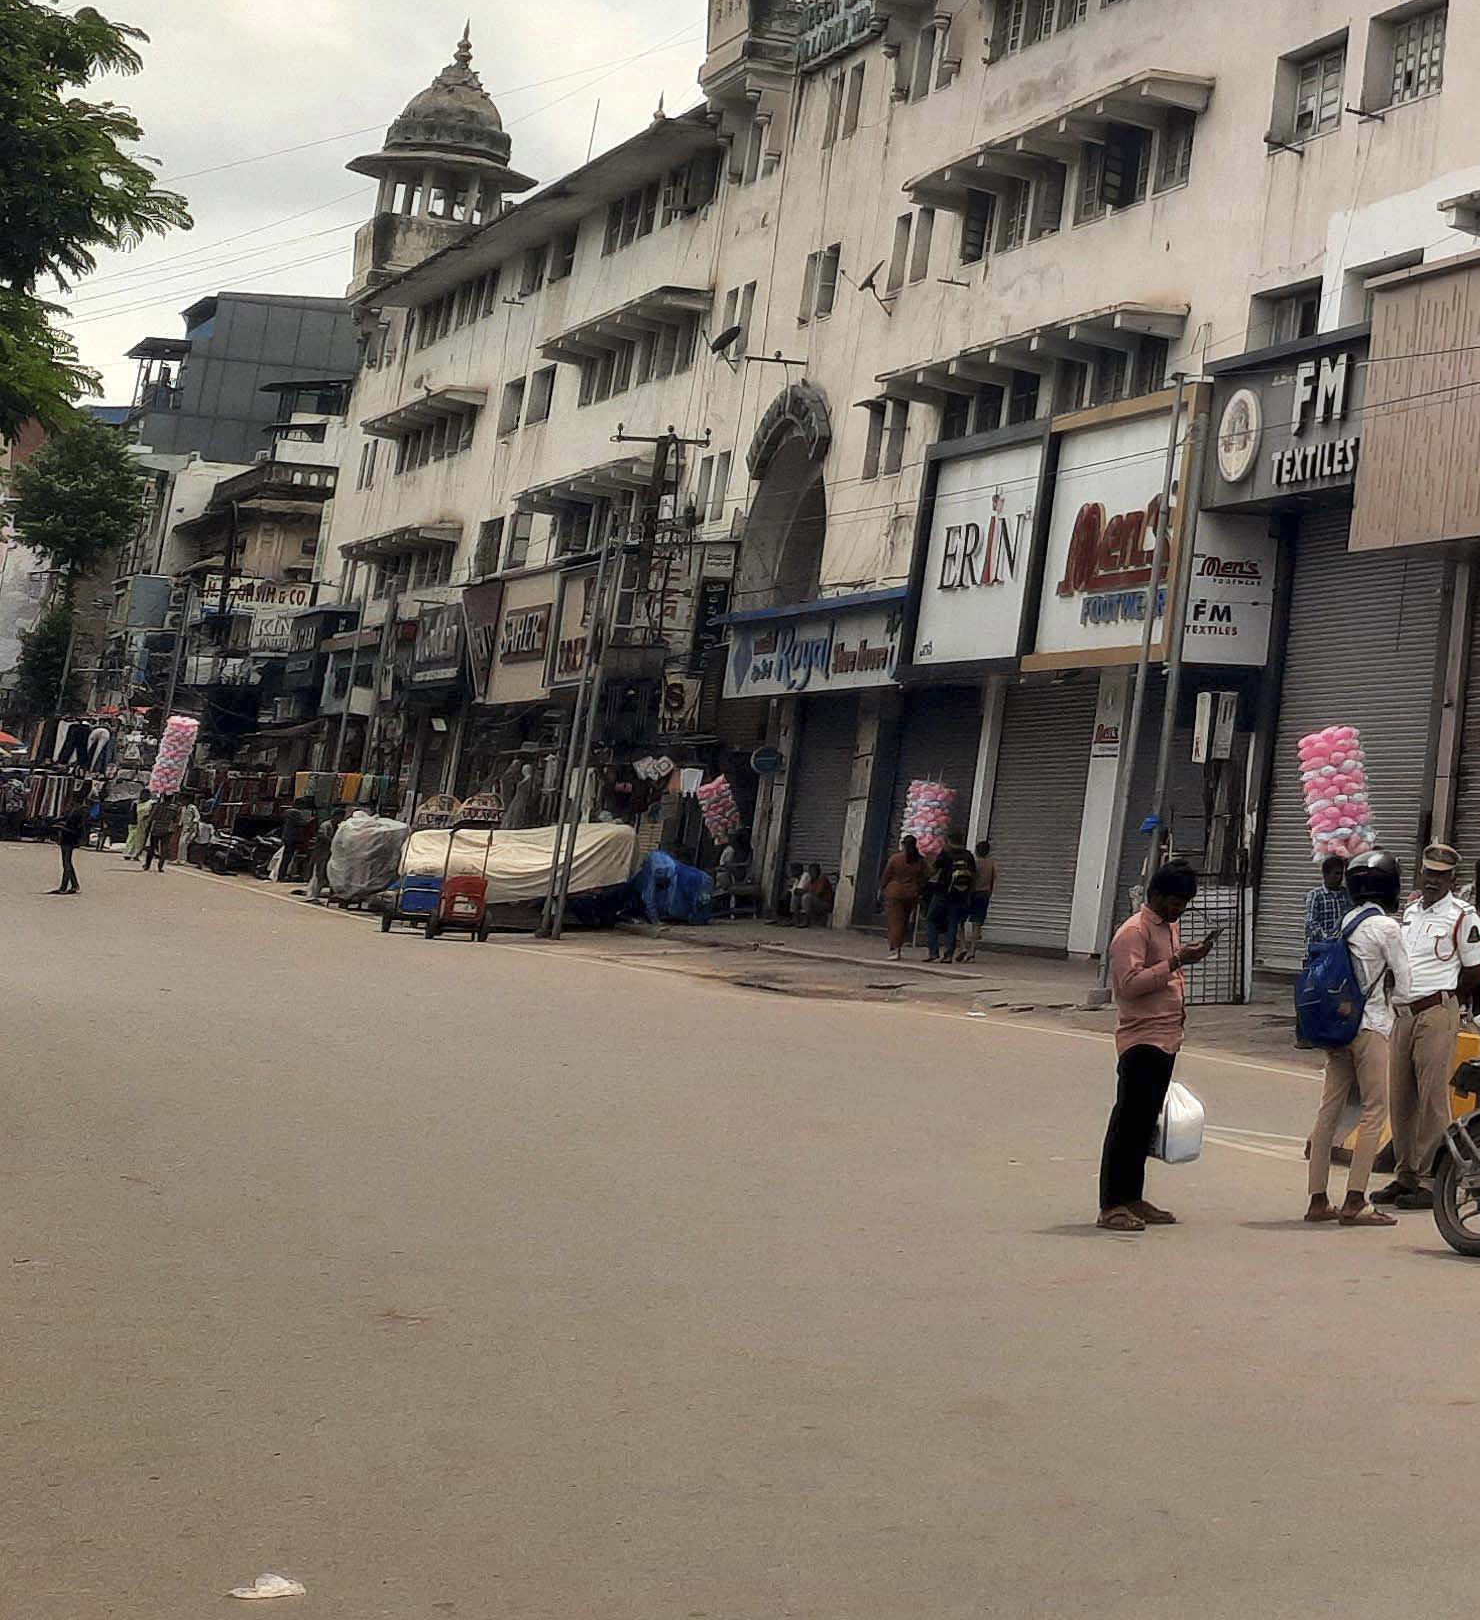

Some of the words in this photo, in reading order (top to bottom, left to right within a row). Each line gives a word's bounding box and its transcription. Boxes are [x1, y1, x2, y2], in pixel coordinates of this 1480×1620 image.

[1291, 352, 1349, 436] FM
[1271, 436, 1360, 485] TEXTILES
[1192, 598, 1232, 623] FM
[1184, 625, 1238, 637] TEXTILES
